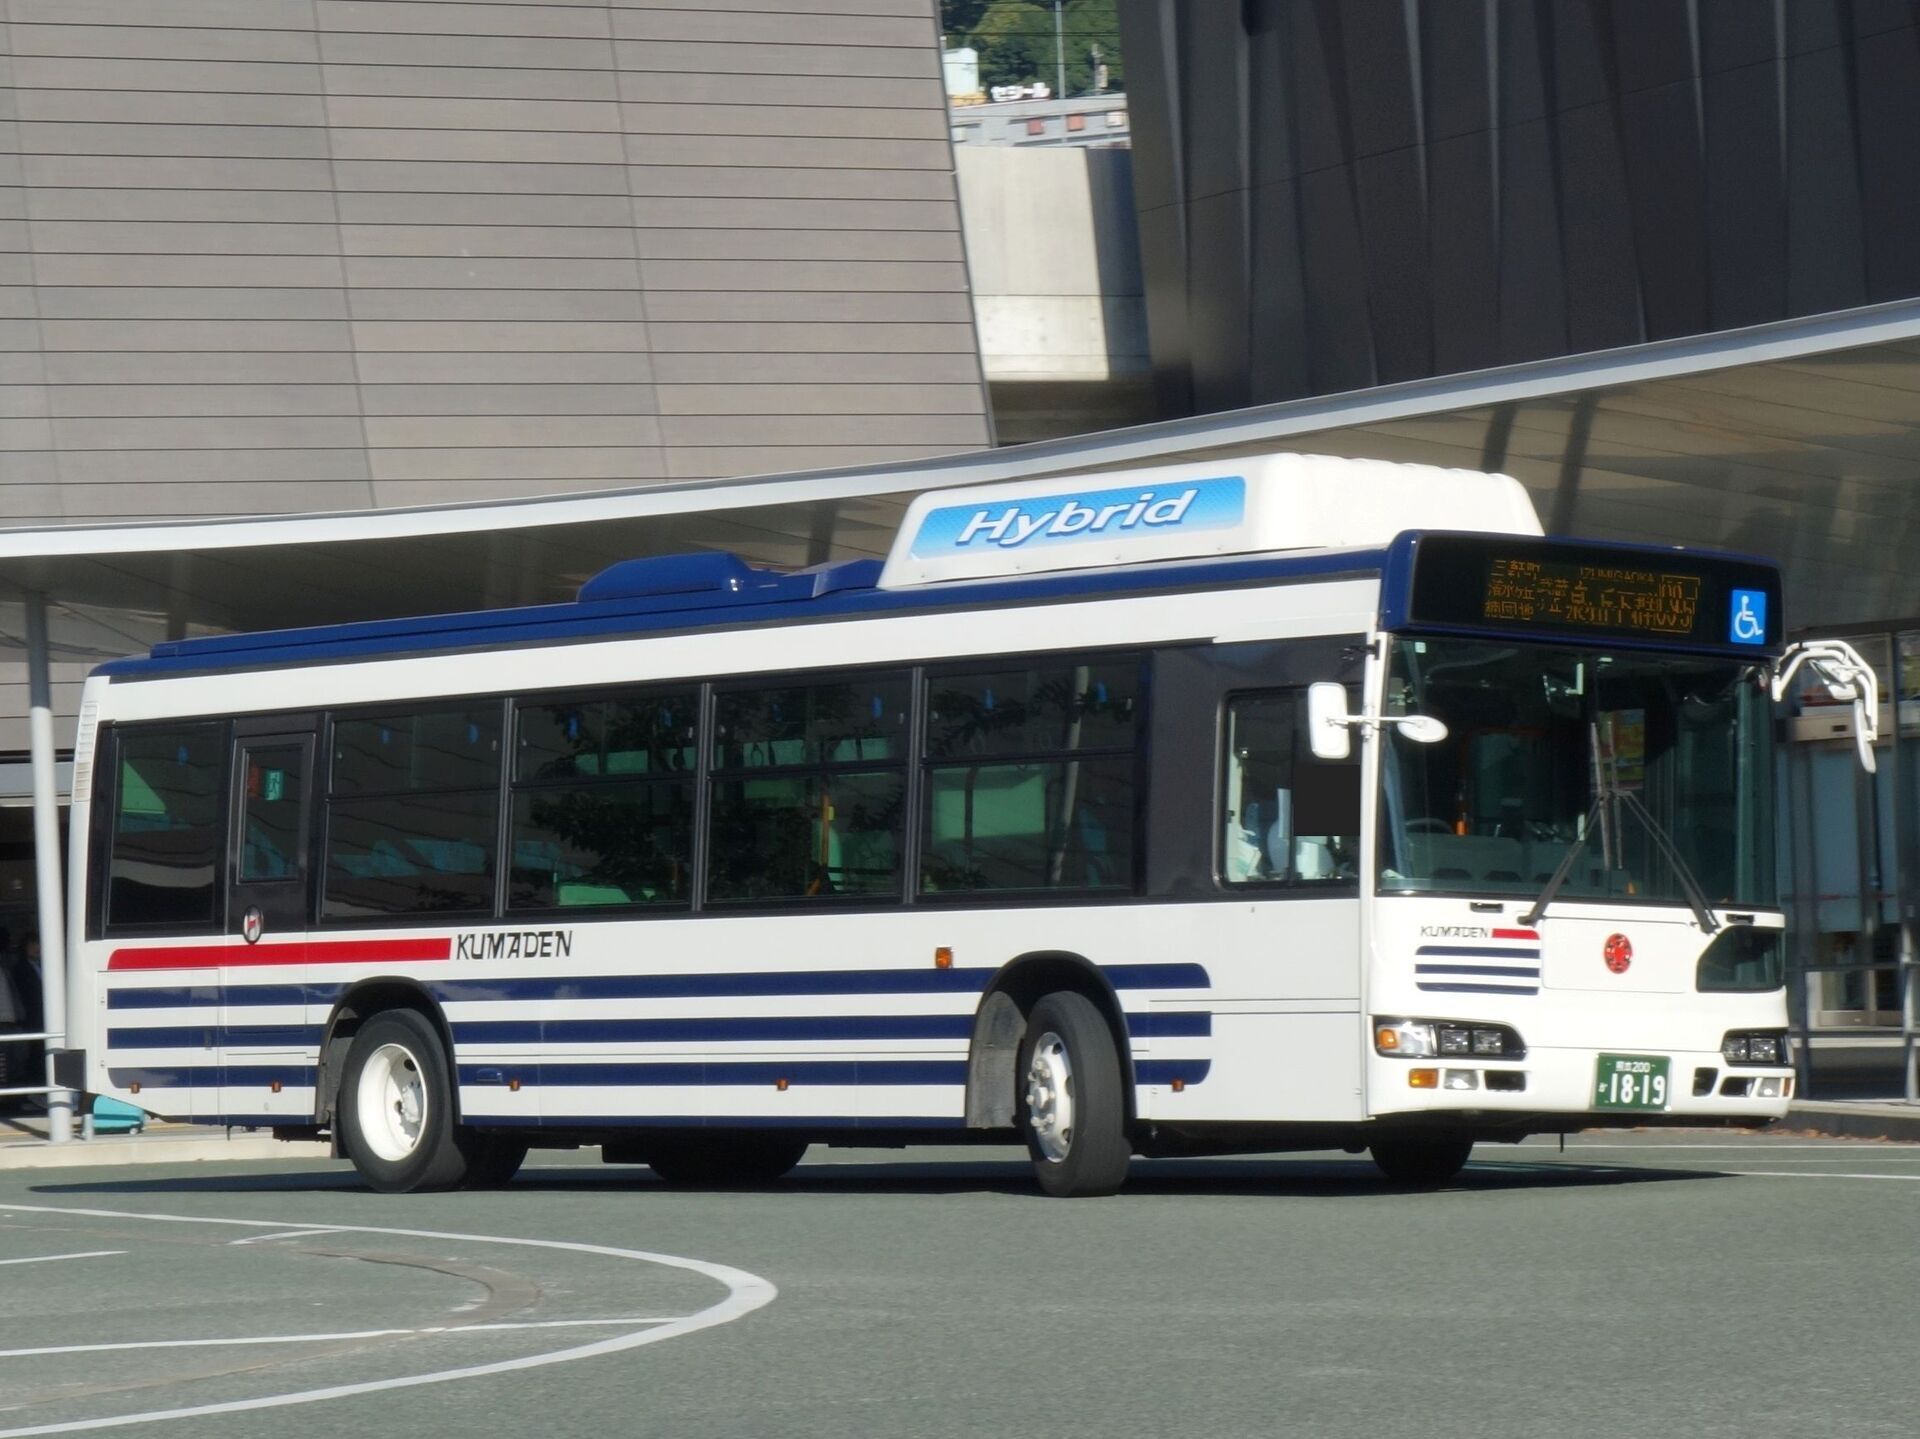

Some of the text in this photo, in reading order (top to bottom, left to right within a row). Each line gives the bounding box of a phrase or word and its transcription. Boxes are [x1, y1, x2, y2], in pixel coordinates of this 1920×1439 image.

[956, 489, 1200, 547] Hybrid
[456, 930, 573, 960] KUMADEN
[1420, 926, 1488, 938] KUMADEN
[1610, 1073, 1666, 1105] 18-19
